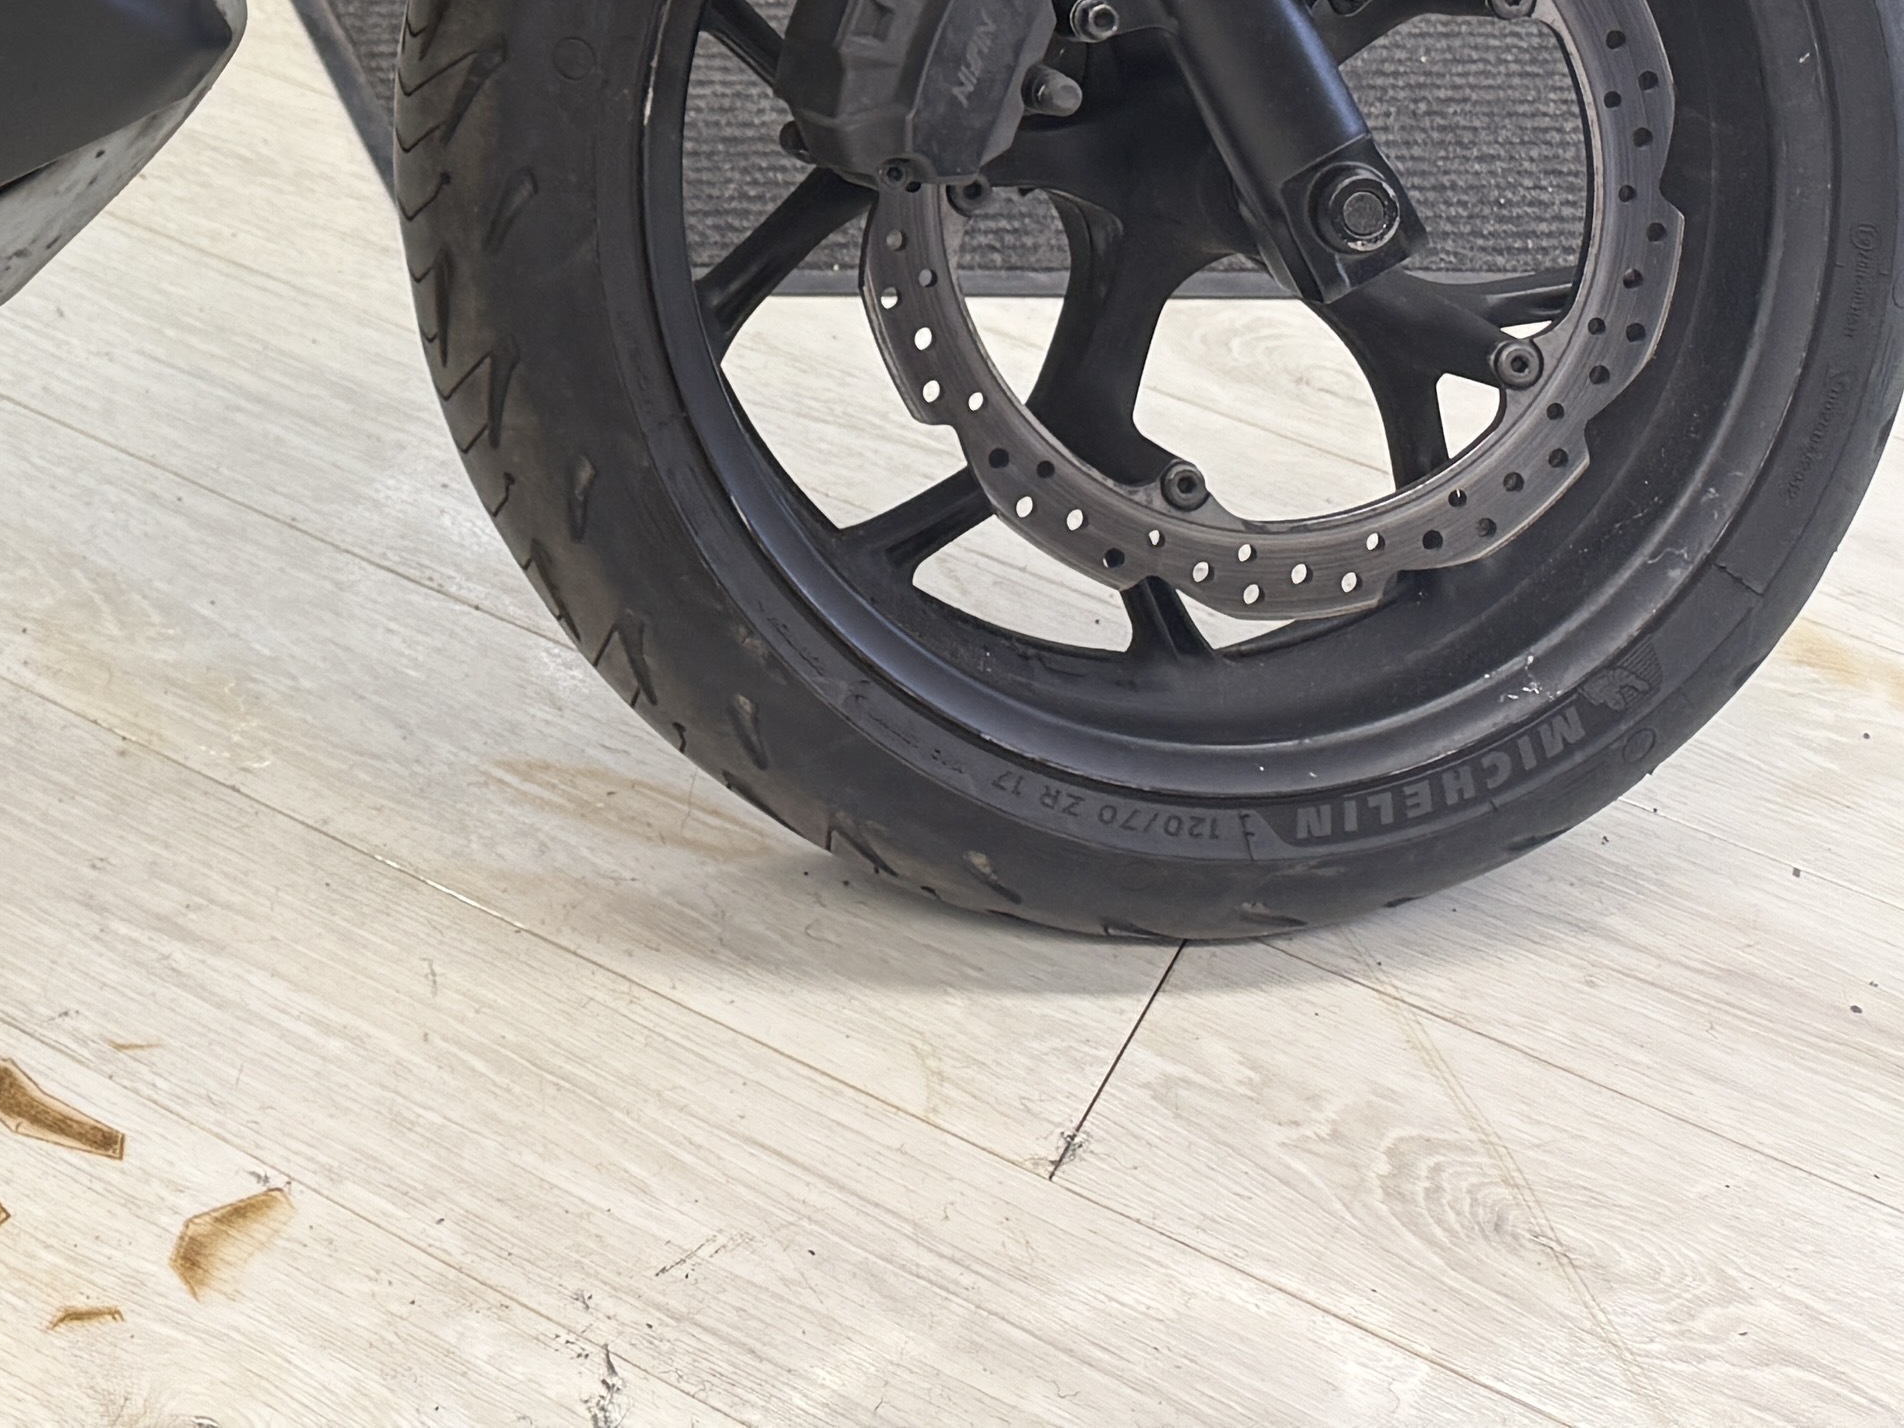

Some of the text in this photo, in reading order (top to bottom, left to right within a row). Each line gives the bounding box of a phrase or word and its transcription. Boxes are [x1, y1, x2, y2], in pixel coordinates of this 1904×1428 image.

[989, 763, 1222, 841] 120/70 ZR 17
[1292, 702, 1592, 841] MICHELIN
